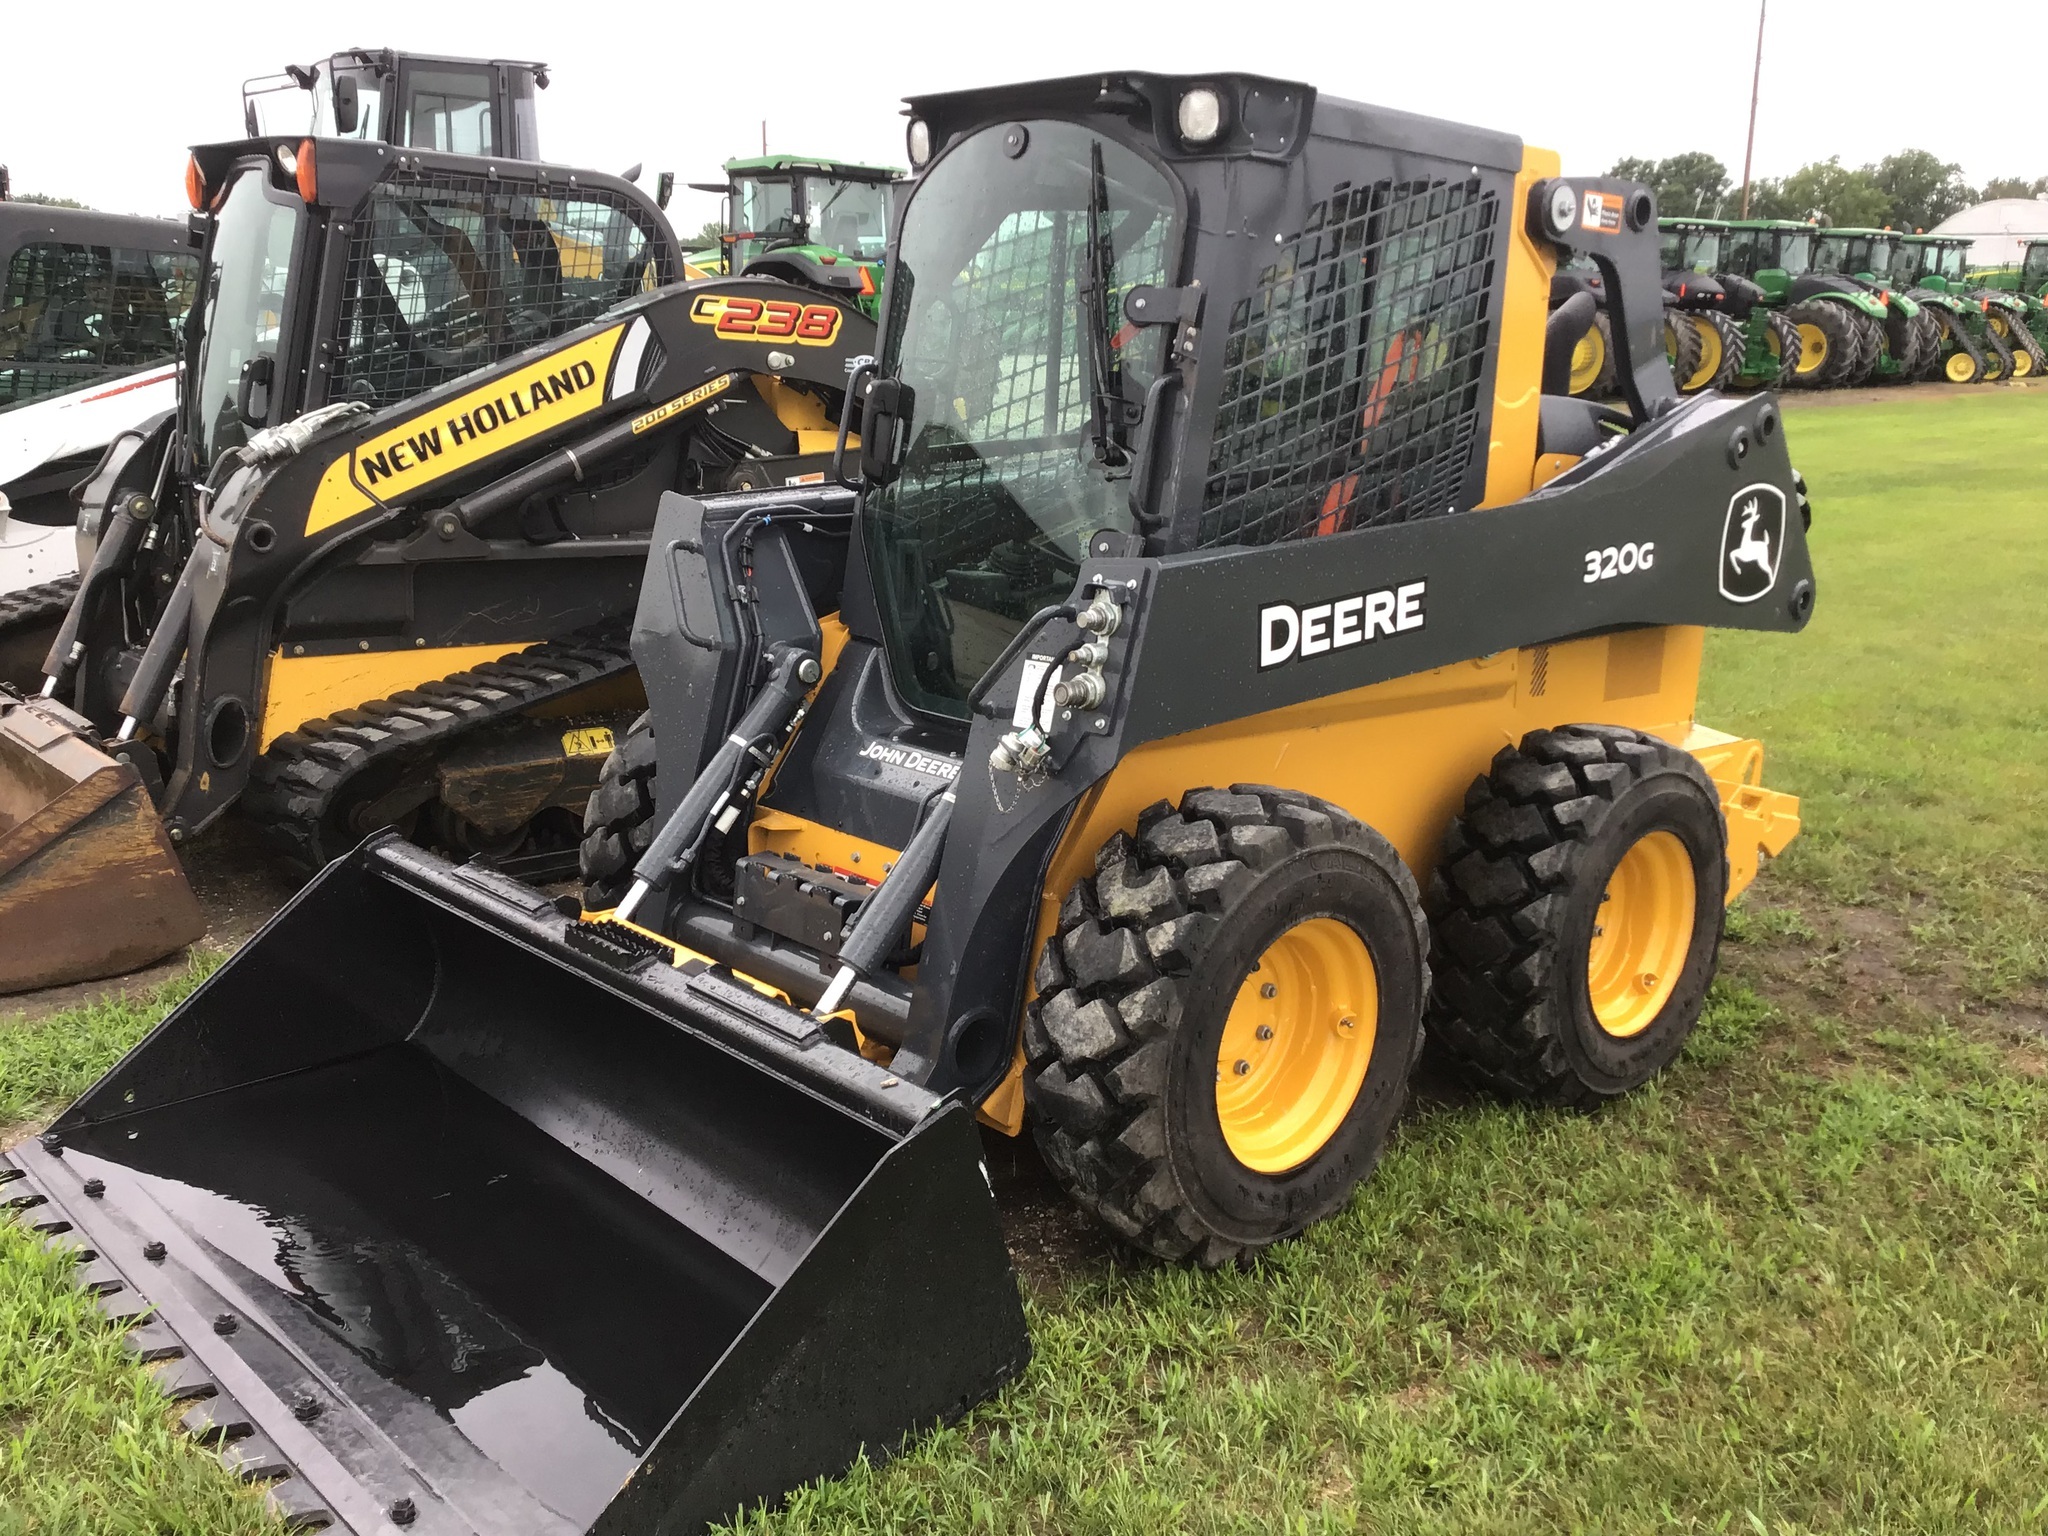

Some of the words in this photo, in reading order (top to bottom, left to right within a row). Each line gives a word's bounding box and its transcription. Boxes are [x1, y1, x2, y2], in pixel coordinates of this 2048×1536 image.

[693, 297, 839, 341] C238
[360, 425, 443, 486] NEW
[446, 359, 596, 447] HOLLAND
[633, 407, 667, 431] 200
[671, 375, 728, 413] SERIES
[1583, 542, 1655, 584] 320G
[1260, 581, 1426, 668] DEERE
[1031, 653, 1056, 662] IMPORTAN
[859, 741, 907, 766] JOHN
[903, 751, 961, 780] DEERE
